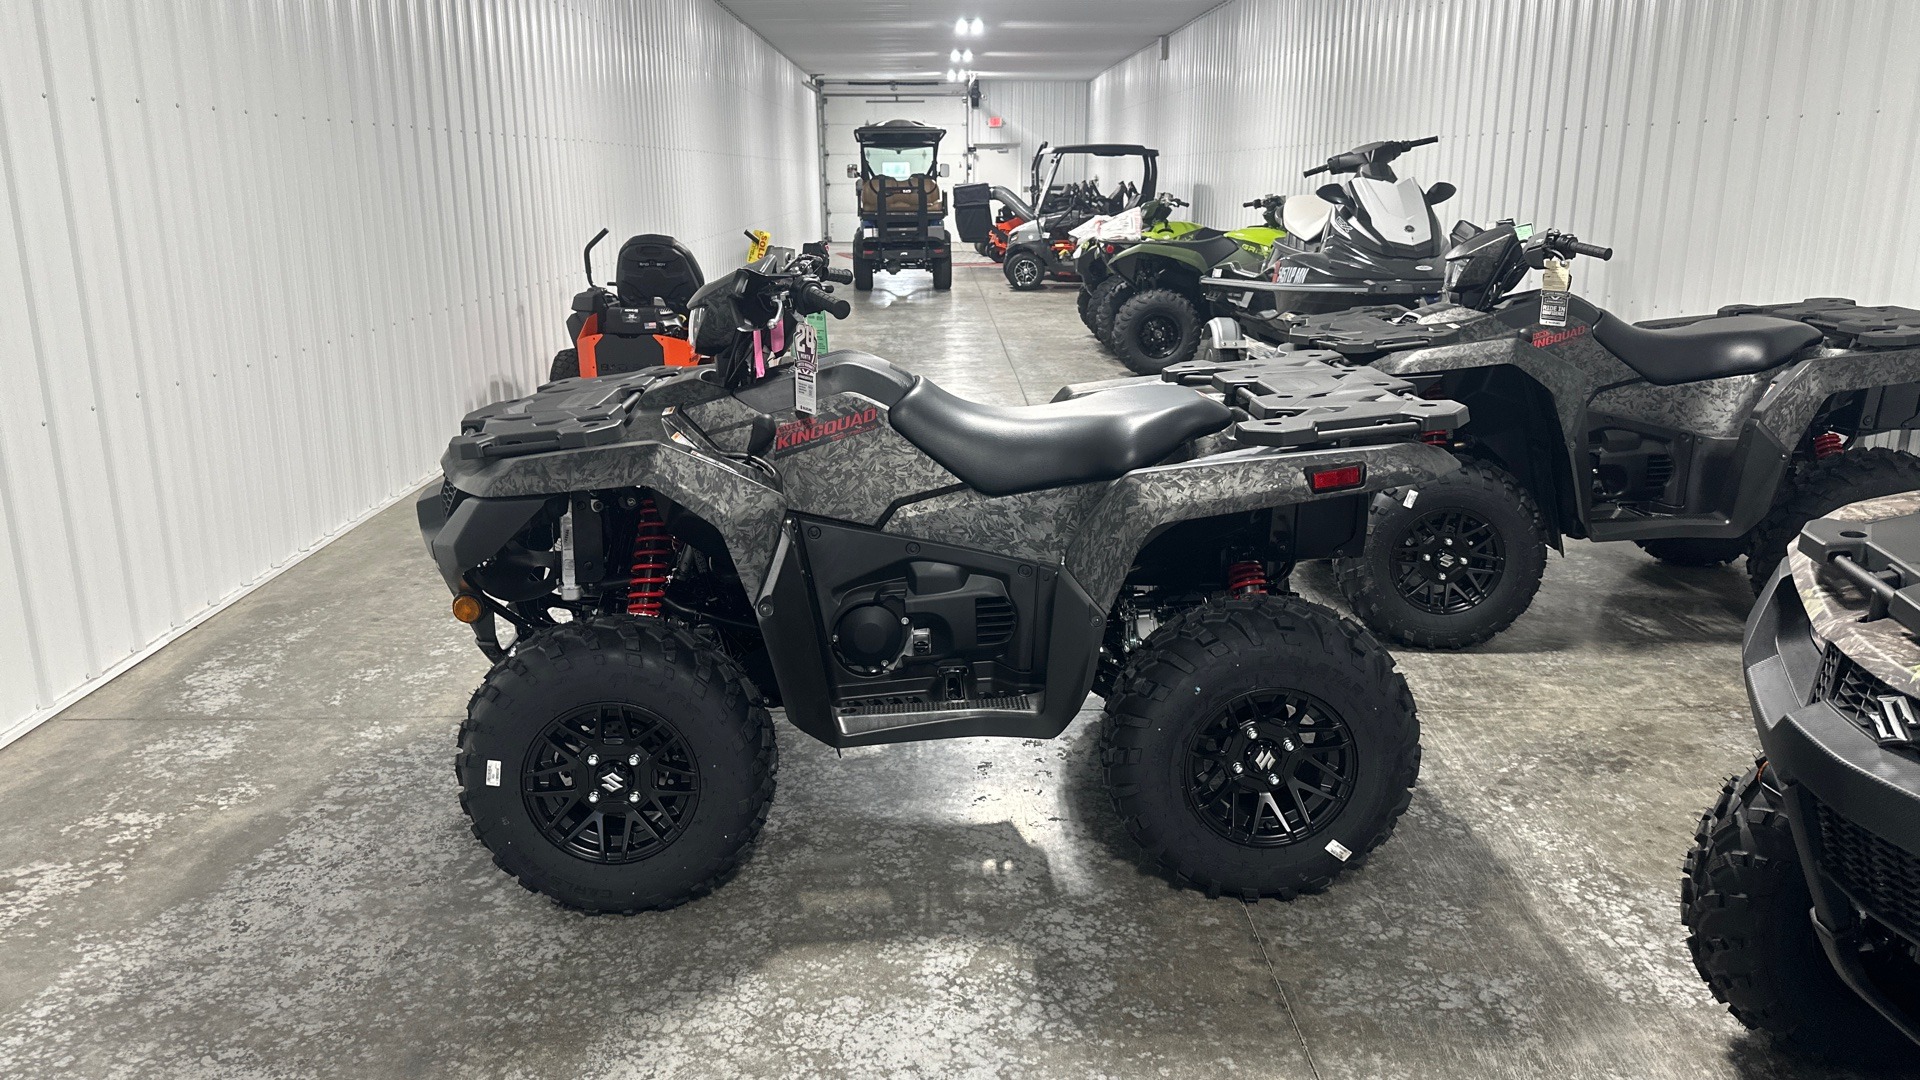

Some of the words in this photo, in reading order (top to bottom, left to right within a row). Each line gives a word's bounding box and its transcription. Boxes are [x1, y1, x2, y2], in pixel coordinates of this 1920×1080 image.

[757, 235, 768, 260] SOLD
[1533, 326, 1585, 346] INGQUAD
[777, 408, 877, 450] KINGQUAD
